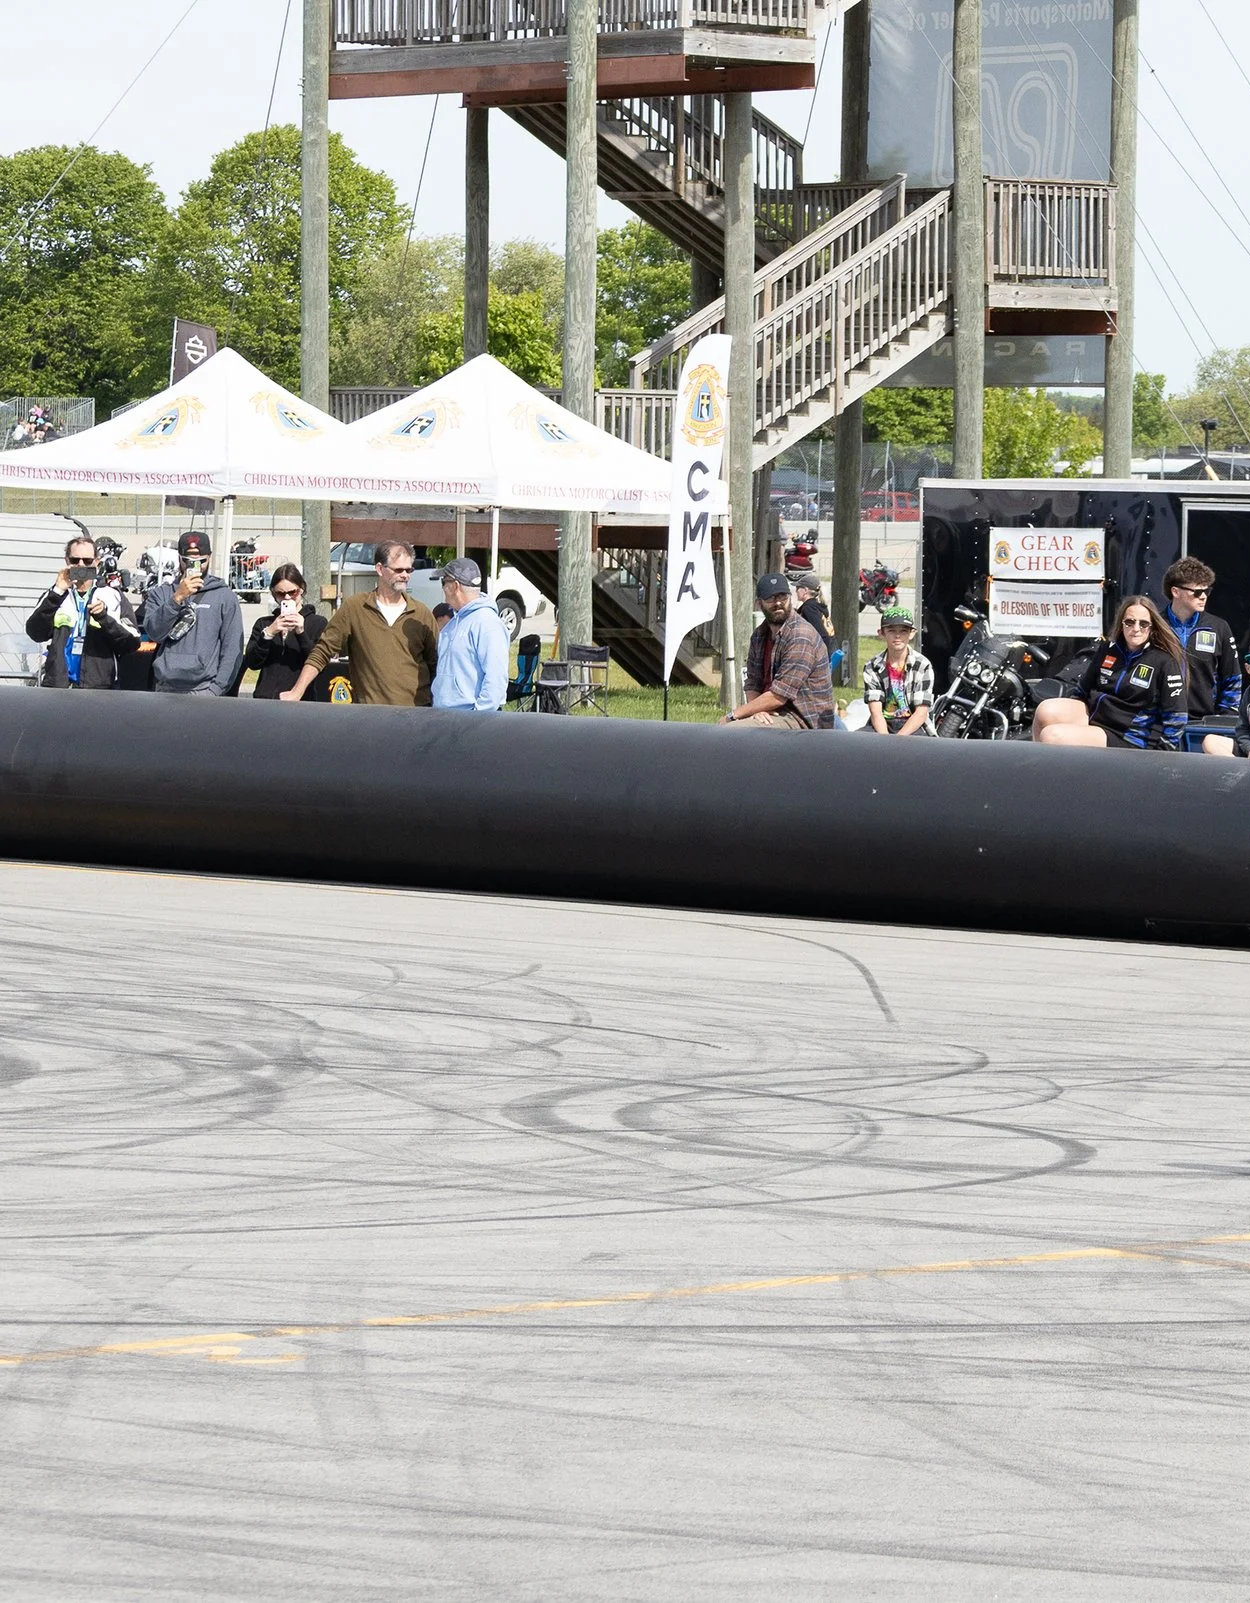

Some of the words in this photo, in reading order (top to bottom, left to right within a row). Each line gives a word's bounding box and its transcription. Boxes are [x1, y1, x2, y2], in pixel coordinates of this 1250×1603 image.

[54, 469, 141, 485] MOTORCYCLISTS
[143, 472, 215, 485] ASSOCIATION
[243, 472, 305, 488] CHRISTIAN
[307, 475, 401, 492] MOTORCYCLISTS
[403, 480, 481, 495] ASSOCIATION
[511, 484, 566, 498] CHRISTIAN
[568, 486, 650, 501] MOTORCYCLISTS
[676, 460, 710, 603] CMA
[1021, 535, 1074, 551] GEAR
[1013, 556, 1081, 571] CHECK
[1001, 600, 1039, 617] BLESSING
[1040, 602, 1051, 617] OF
[1054, 603, 1070, 617] THE
[1072, 603, 1095, 618] BIKES
